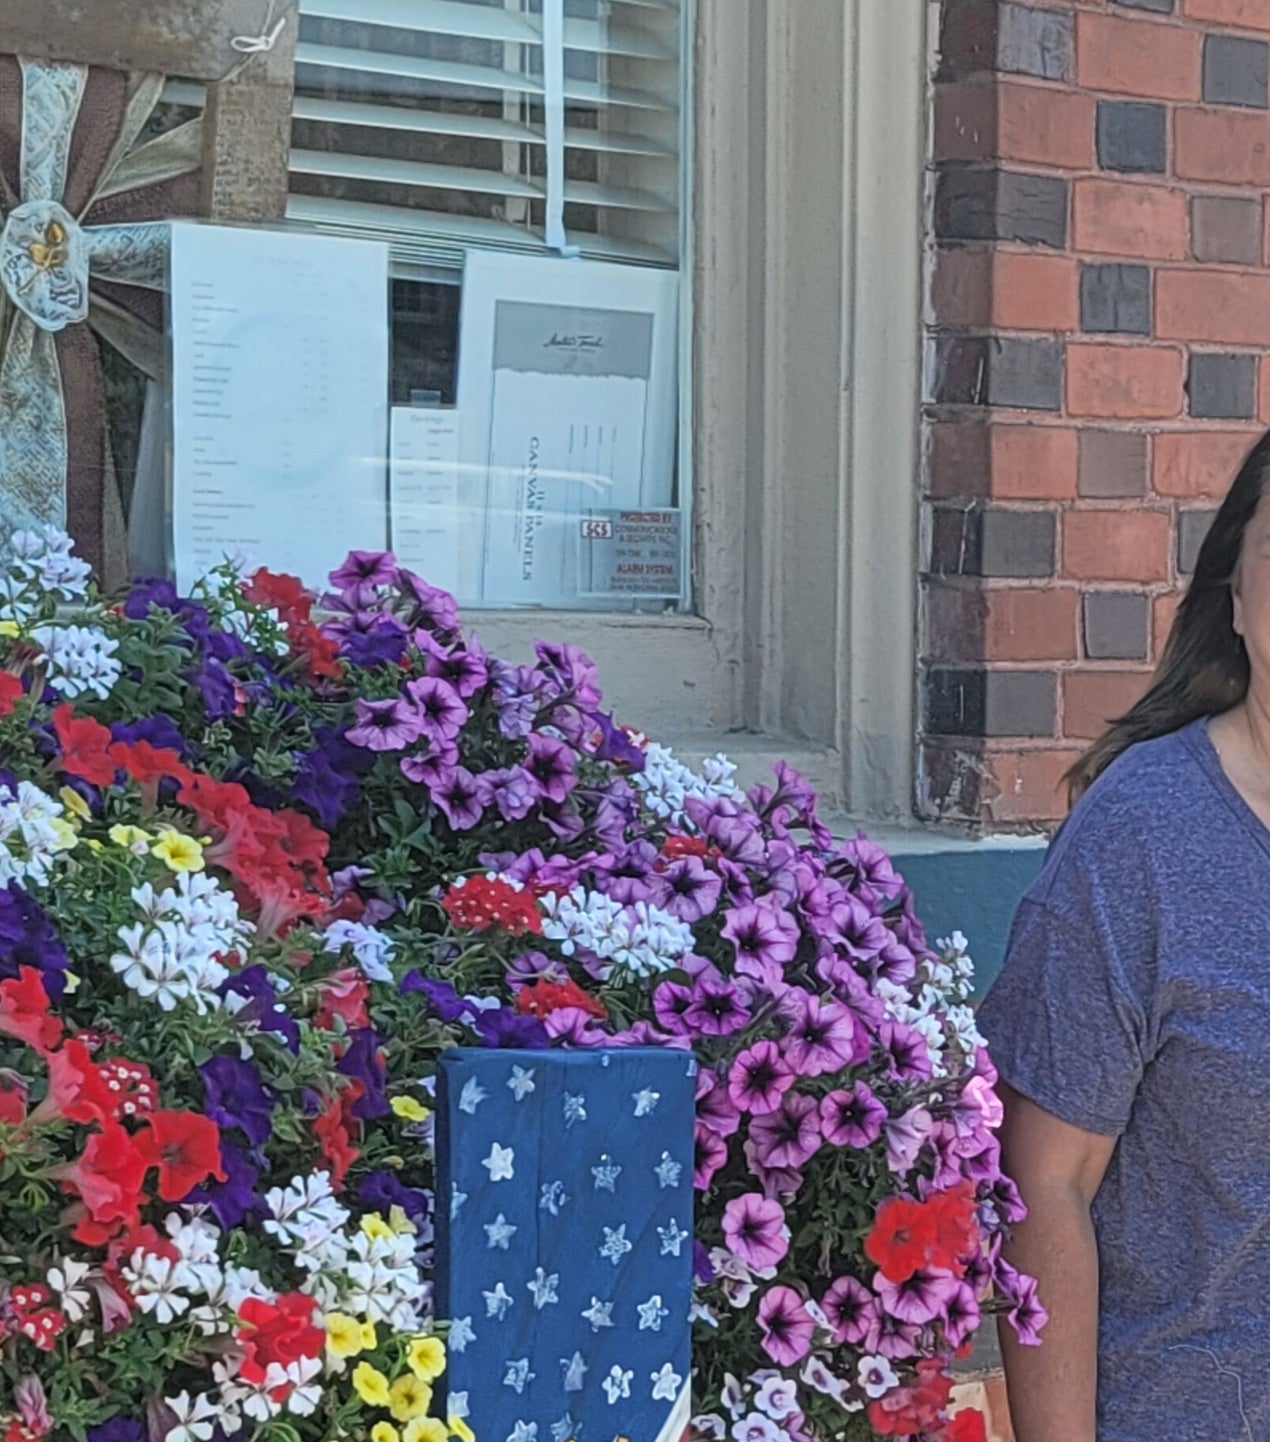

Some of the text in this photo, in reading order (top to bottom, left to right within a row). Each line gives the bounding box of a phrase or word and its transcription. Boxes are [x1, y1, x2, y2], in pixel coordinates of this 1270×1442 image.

[522, 436, 540, 581] CANVAS PANELS
[586, 521, 608, 537] SCS
